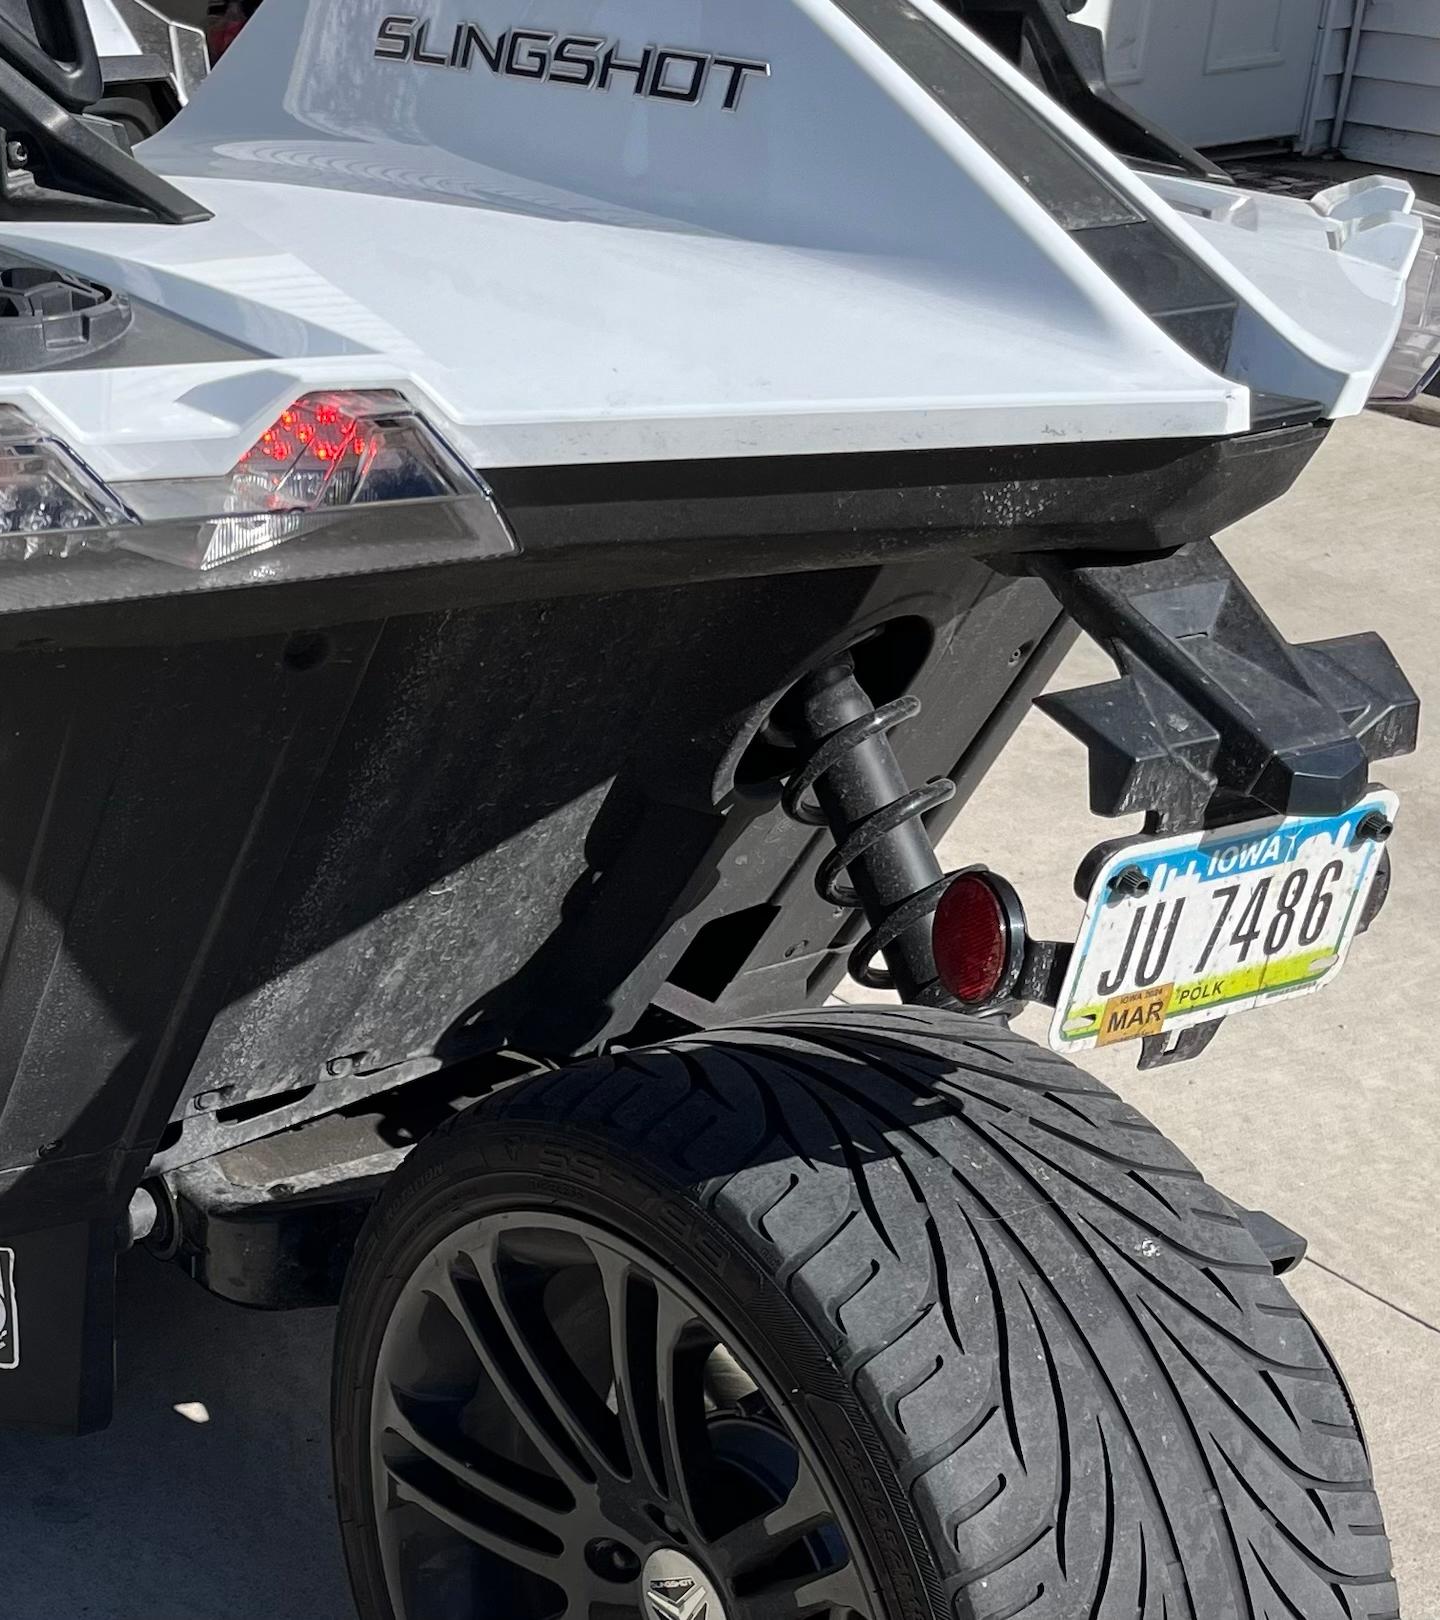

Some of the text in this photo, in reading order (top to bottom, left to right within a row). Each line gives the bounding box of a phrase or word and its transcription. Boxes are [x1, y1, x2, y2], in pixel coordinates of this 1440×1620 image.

[374, 15, 771, 113] SLINGSHOT
[1207, 834, 1281, 877] IOWA
[1097, 859, 1344, 997] JU 7486
[1120, 993, 1143, 1004] IOWA
[1179, 980, 1225, 1004] POLK
[1107, 1000, 1164, 1033] MAR
